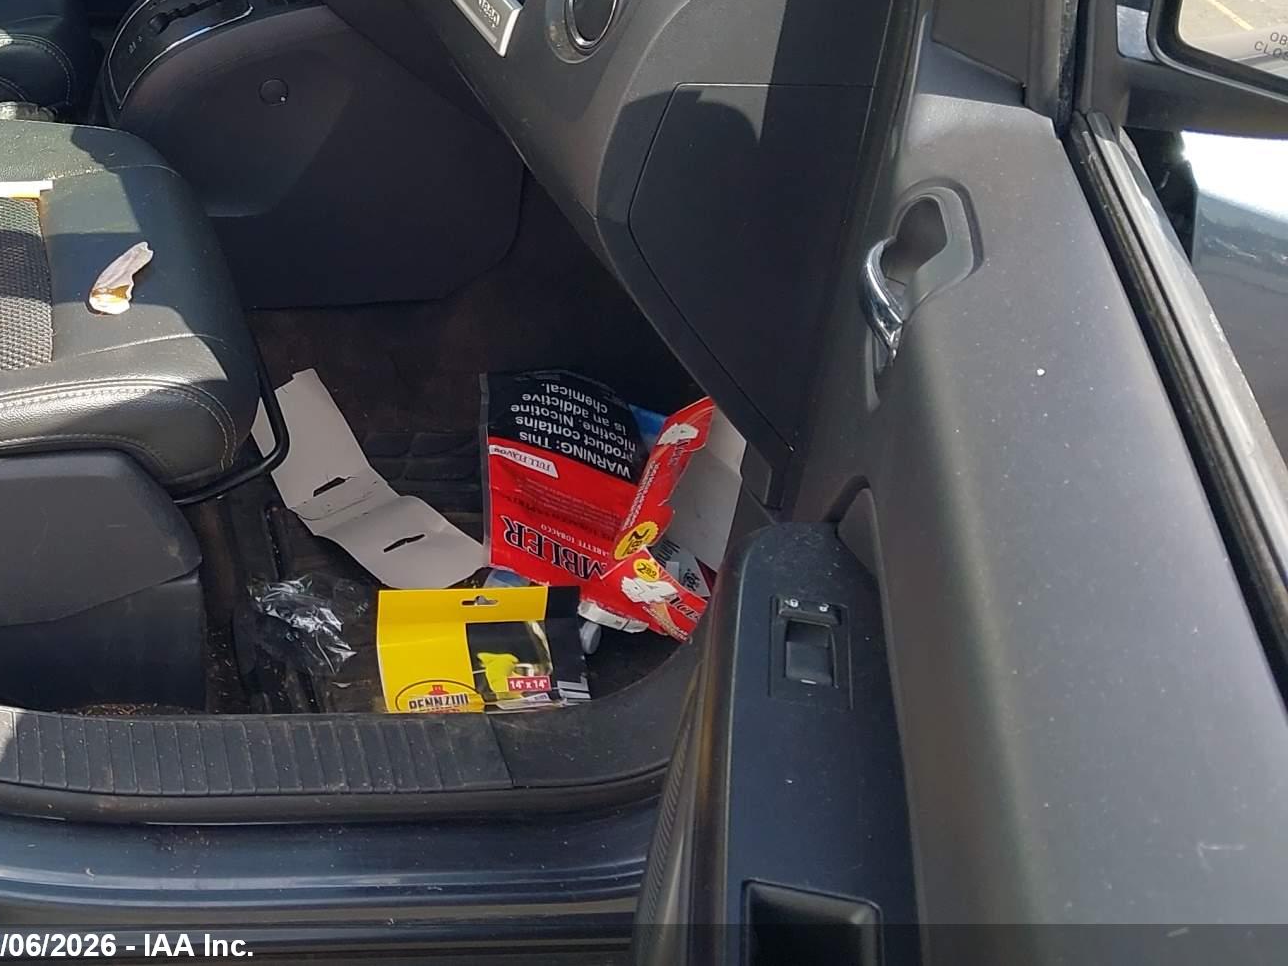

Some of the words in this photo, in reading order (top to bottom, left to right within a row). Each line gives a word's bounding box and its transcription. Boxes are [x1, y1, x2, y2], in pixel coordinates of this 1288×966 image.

[522, 393, 589, 418] addictive
[541, 383, 608, 414] chemical.
[511, 404, 574, 427] Nicotine
[593, 413, 610, 427] an
[614, 421, 626, 433] is
[515, 416, 580, 440] contains
[578, 419, 636, 452] nicotine.
[519, 431, 552, 449] This
[584, 435, 633, 463] product
[530, 456, 551, 472] FULL
[555, 440, 632, 479] WARNING:
[540, 523, 575, 543] TOBACCO
[578, 540, 610, 557] ARETTE
